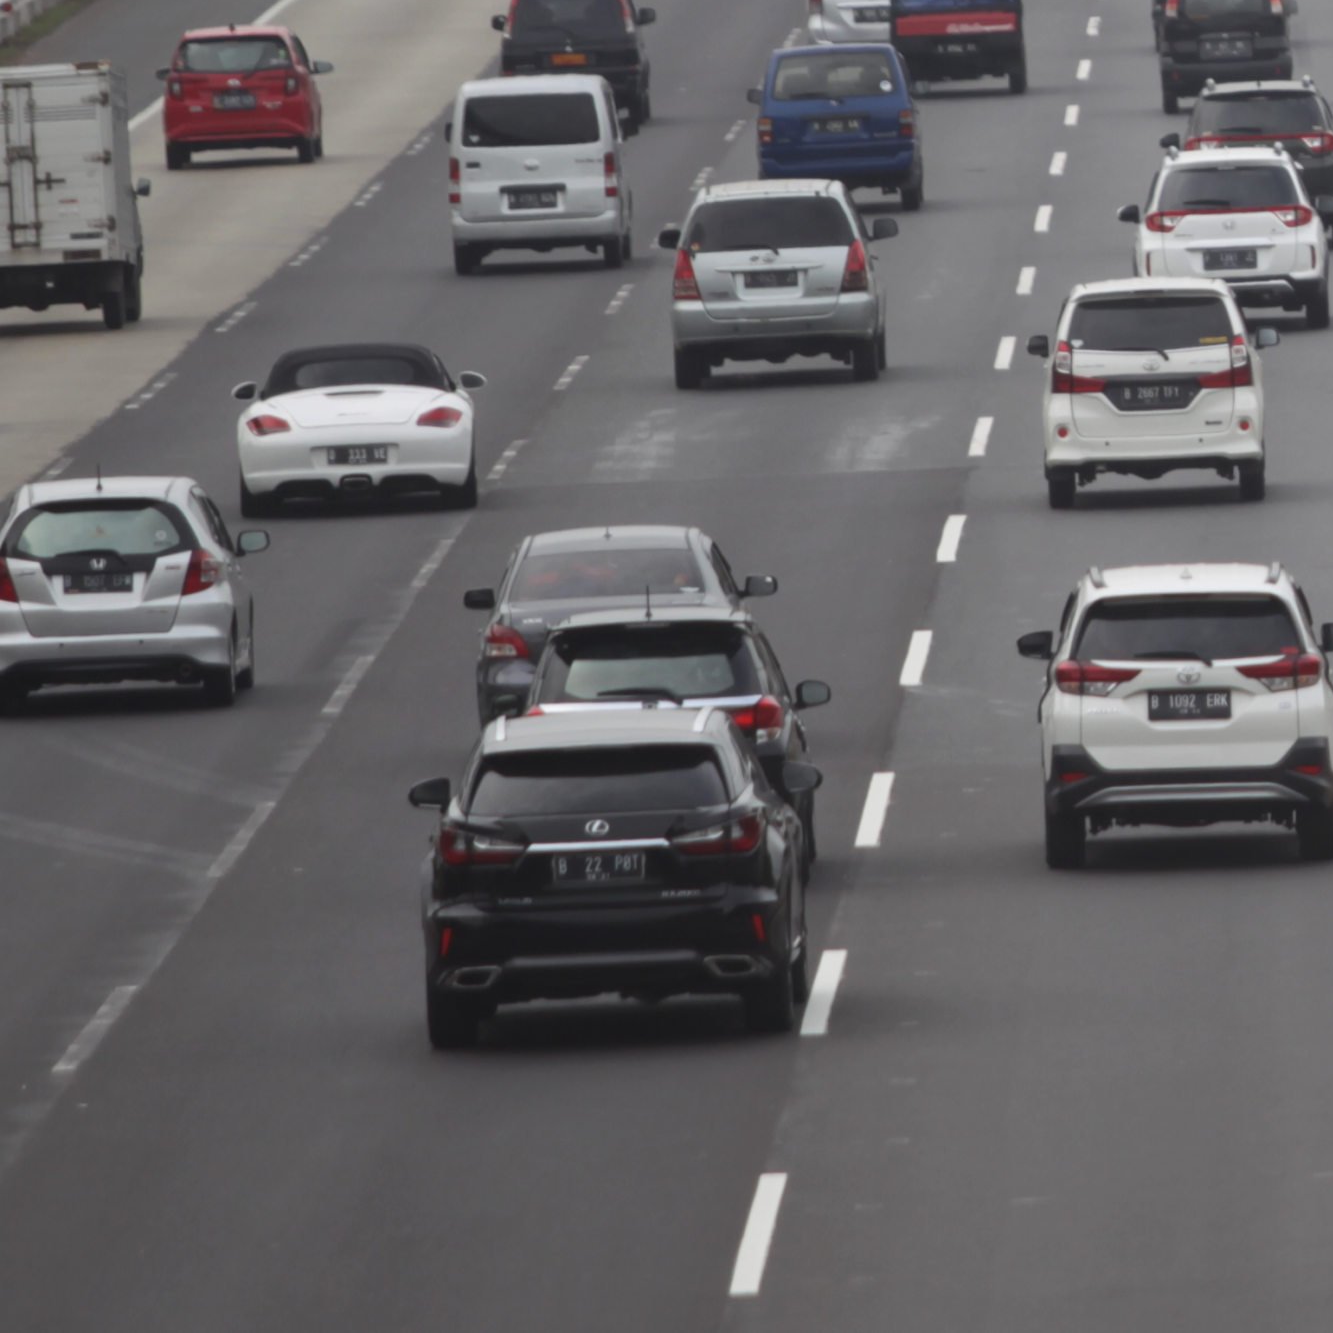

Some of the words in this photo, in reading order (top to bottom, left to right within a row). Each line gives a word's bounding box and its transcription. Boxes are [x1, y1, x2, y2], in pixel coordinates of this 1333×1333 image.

[1151, 694, 1160, 710] B
[1169, 693, 1197, 709] 1092
[1206, 692, 1229, 708] ERK
[558, 857, 568, 875] B
[585, 856, 602, 873] 22
